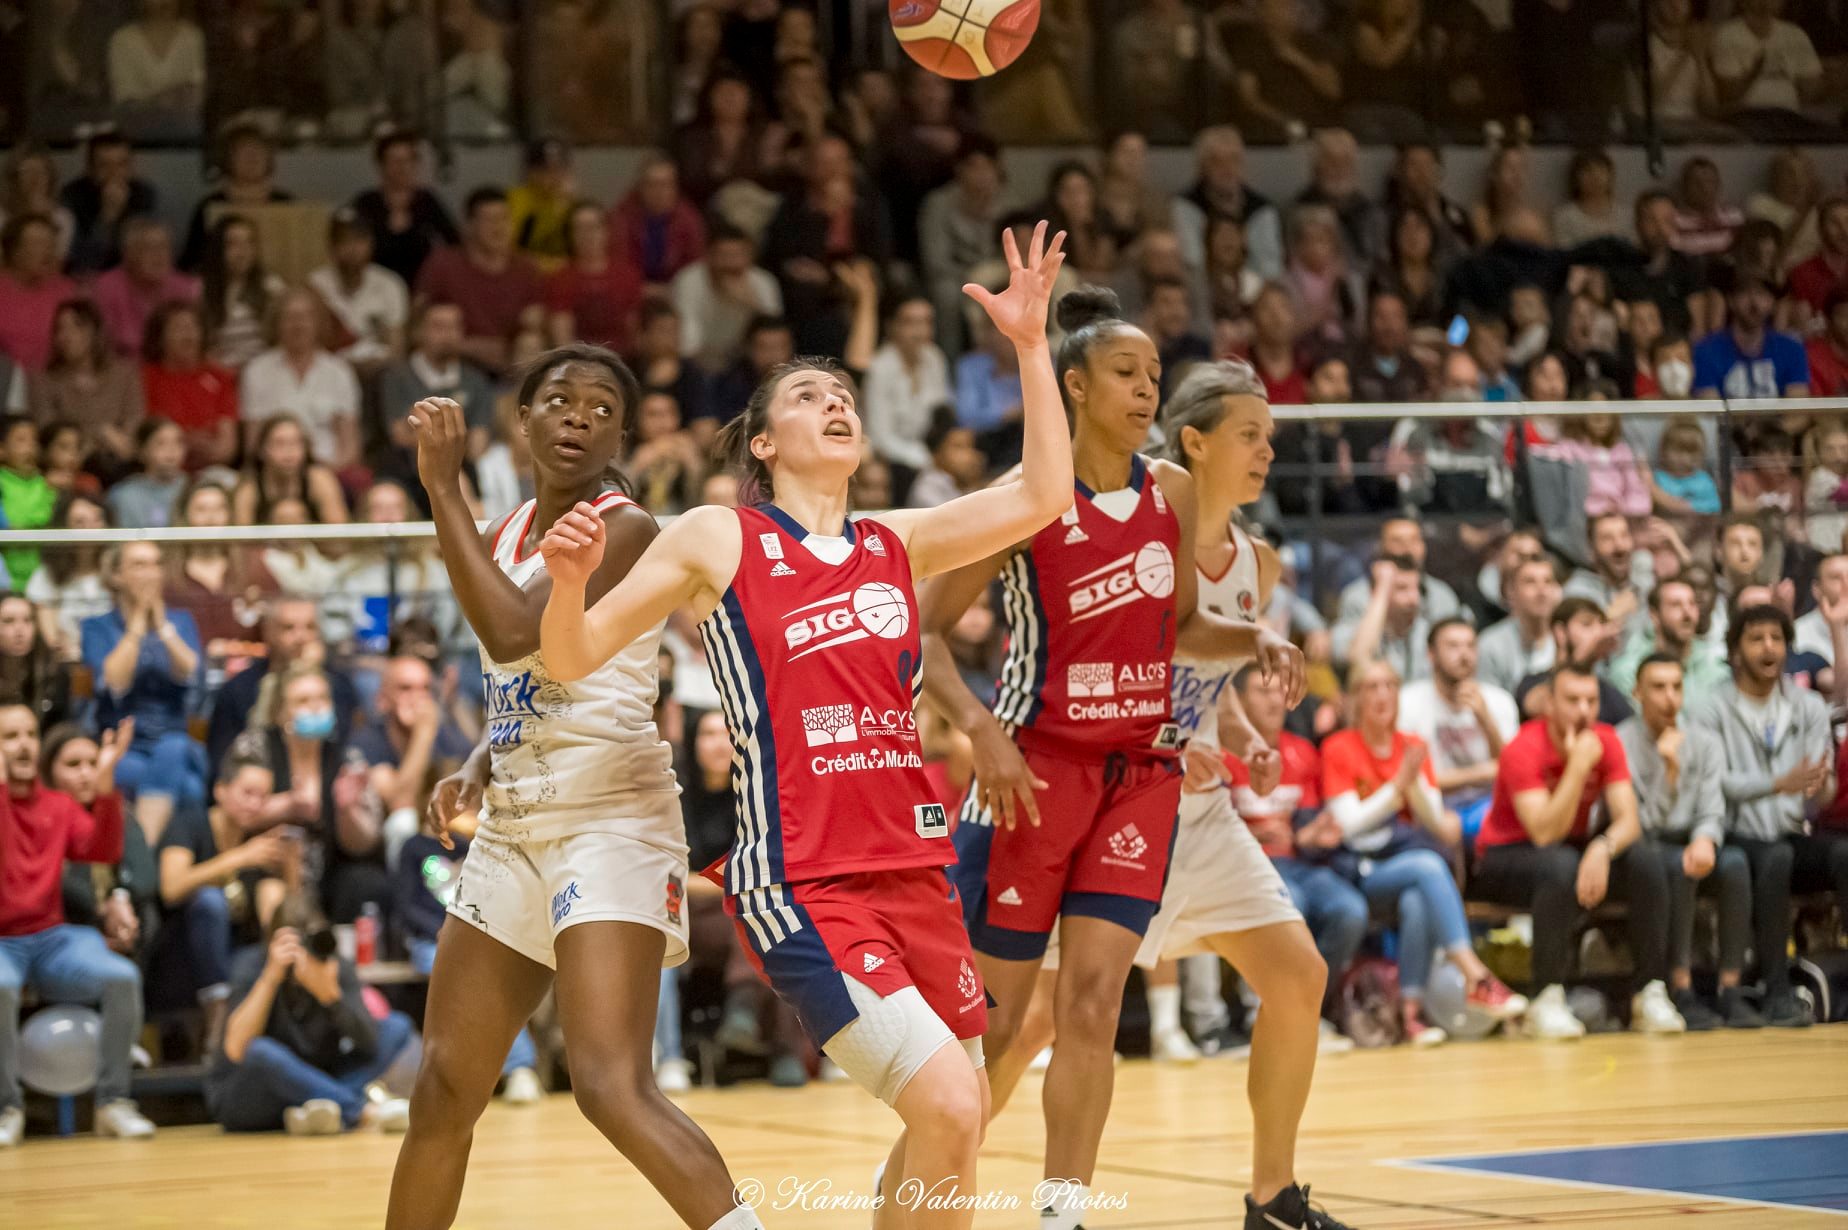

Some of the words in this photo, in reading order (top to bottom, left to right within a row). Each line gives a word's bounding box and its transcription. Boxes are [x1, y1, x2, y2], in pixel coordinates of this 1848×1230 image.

[1068, 569, 1135, 615] SIG
[784, 606, 856, 650] SIG
[1067, 702, 1120, 720] Crédit
[811, 752, 868, 775] Crédit
